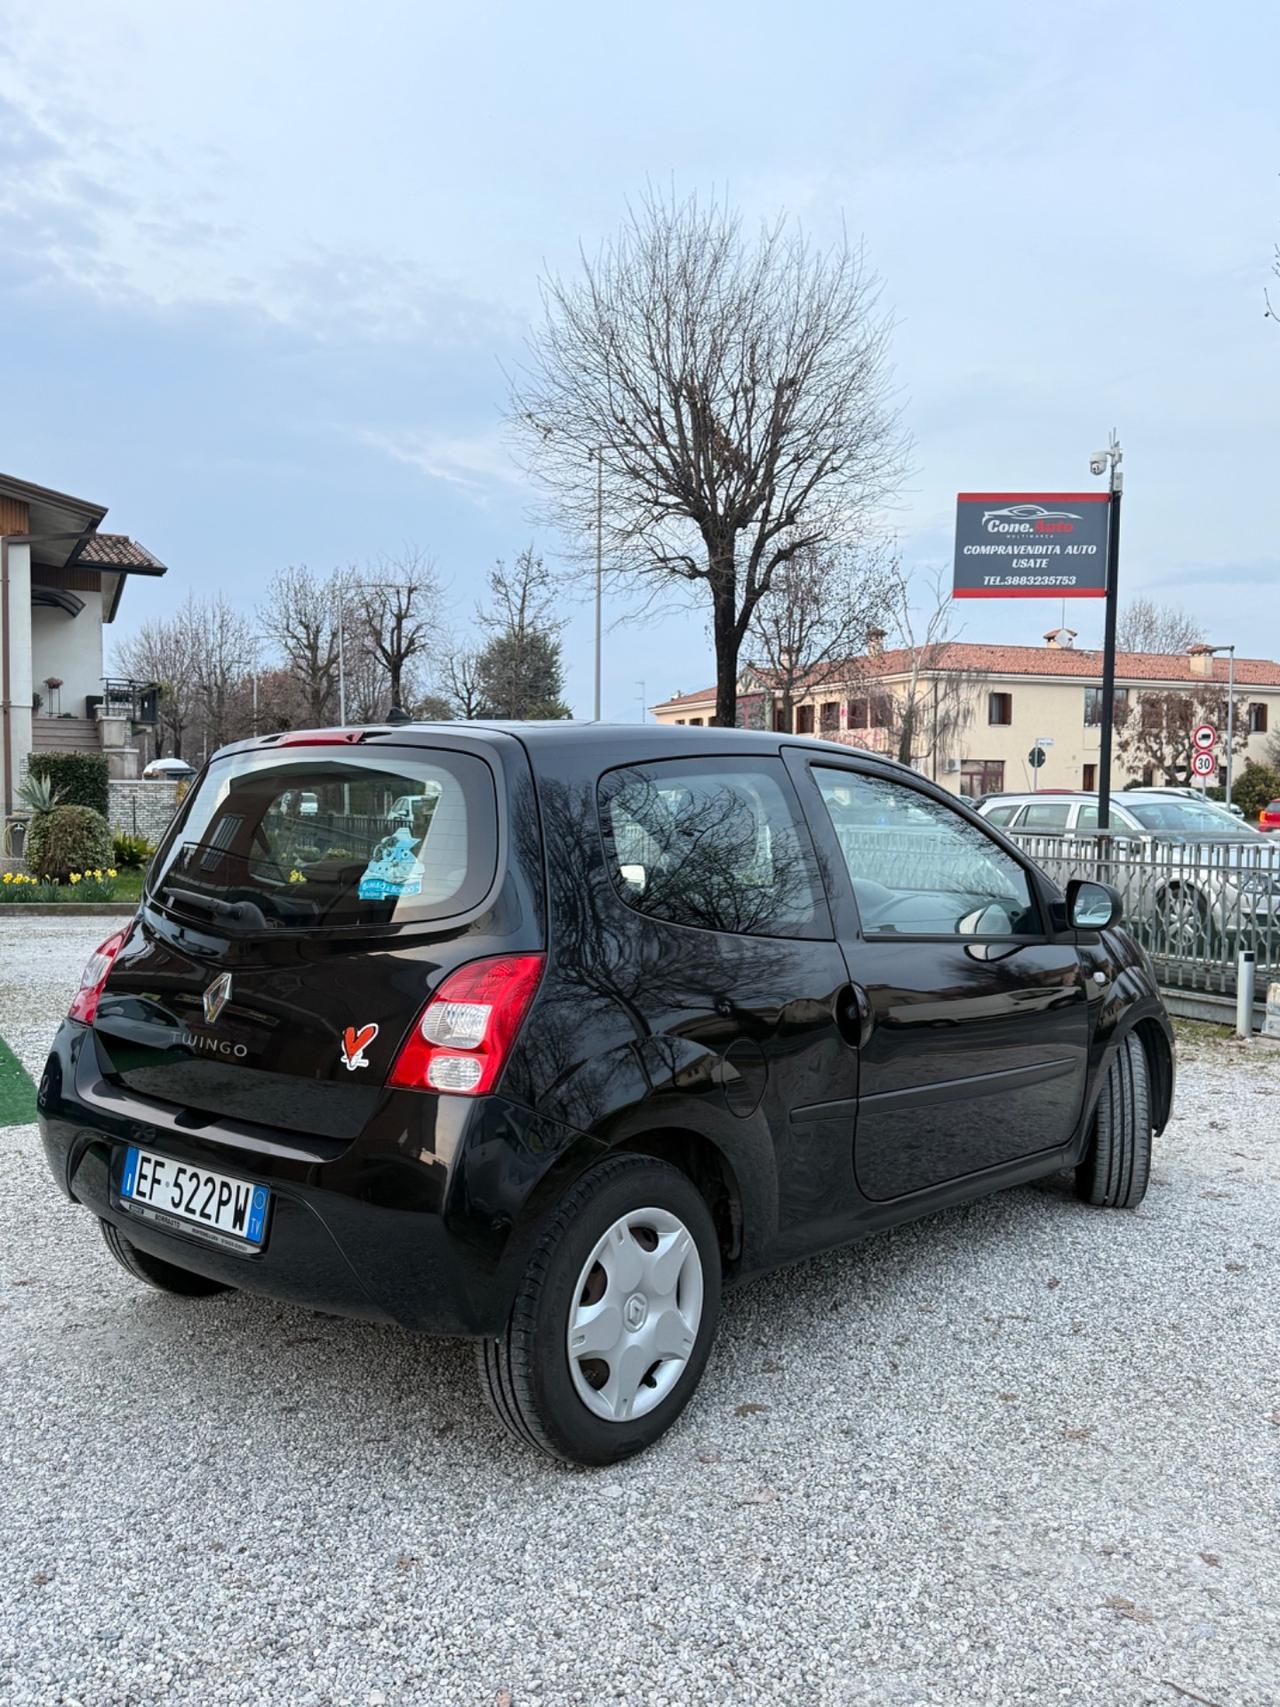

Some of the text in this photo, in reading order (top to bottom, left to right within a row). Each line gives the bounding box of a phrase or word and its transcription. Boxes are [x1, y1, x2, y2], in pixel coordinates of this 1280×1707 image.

[963, 545, 1097, 555] COMPRAVENDITA AUTO
[1012, 558, 1049, 568] USATE
[983, 575, 1076, 585] TEL.3883235753
[1198, 757, 1210, 769] 30
[170, 1030, 248, 1057] TWINGO
